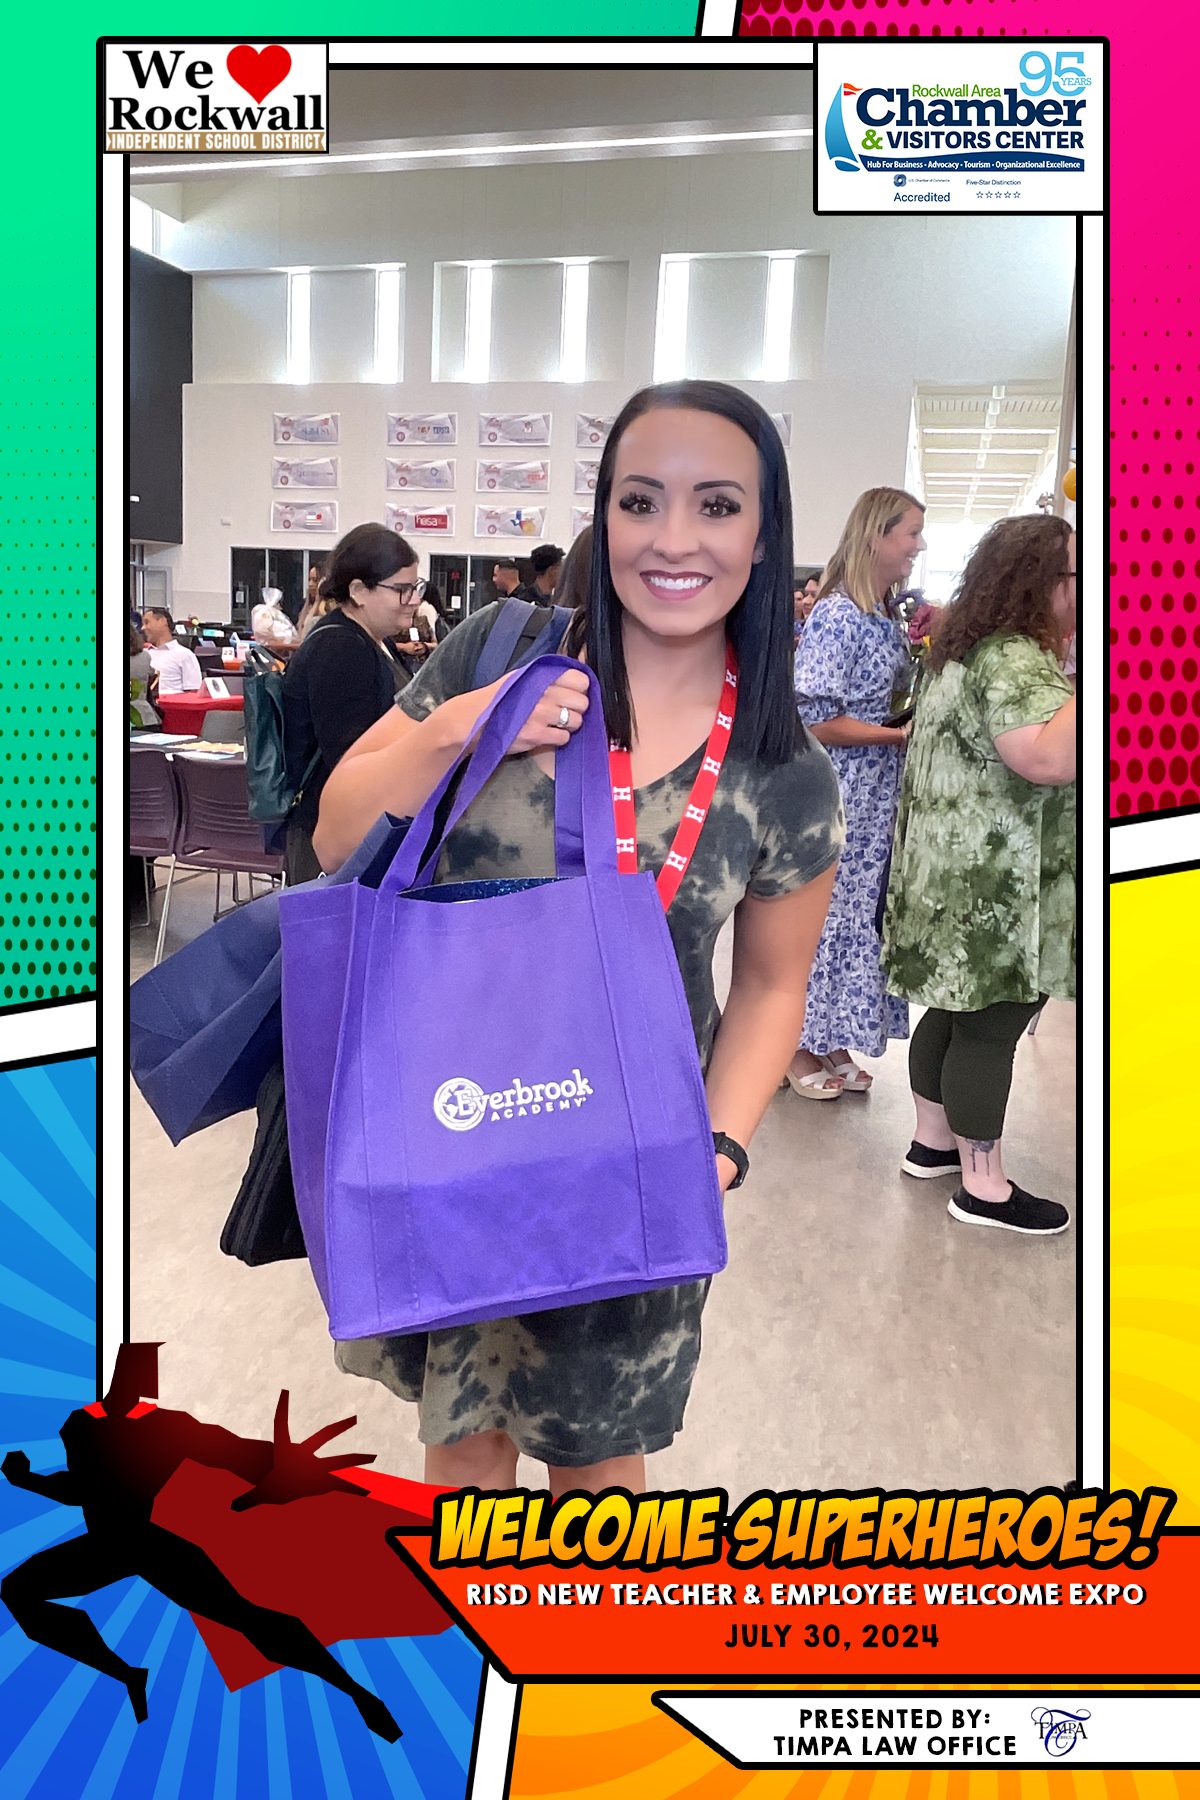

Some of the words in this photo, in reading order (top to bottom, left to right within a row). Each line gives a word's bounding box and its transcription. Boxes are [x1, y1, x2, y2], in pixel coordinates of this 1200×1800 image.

[725, 668, 737, 687] H
[717, 711, 733, 730] H
[703, 756, 721, 776] H
[613, 786, 631, 801] H
[685, 803, 705, 823] H
[616, 837, 635, 853] H
[665, 851, 687, 871] H
[454, 1069, 593, 1116] Everbrook
[491, 1098, 584, 1121] ACADEMY
